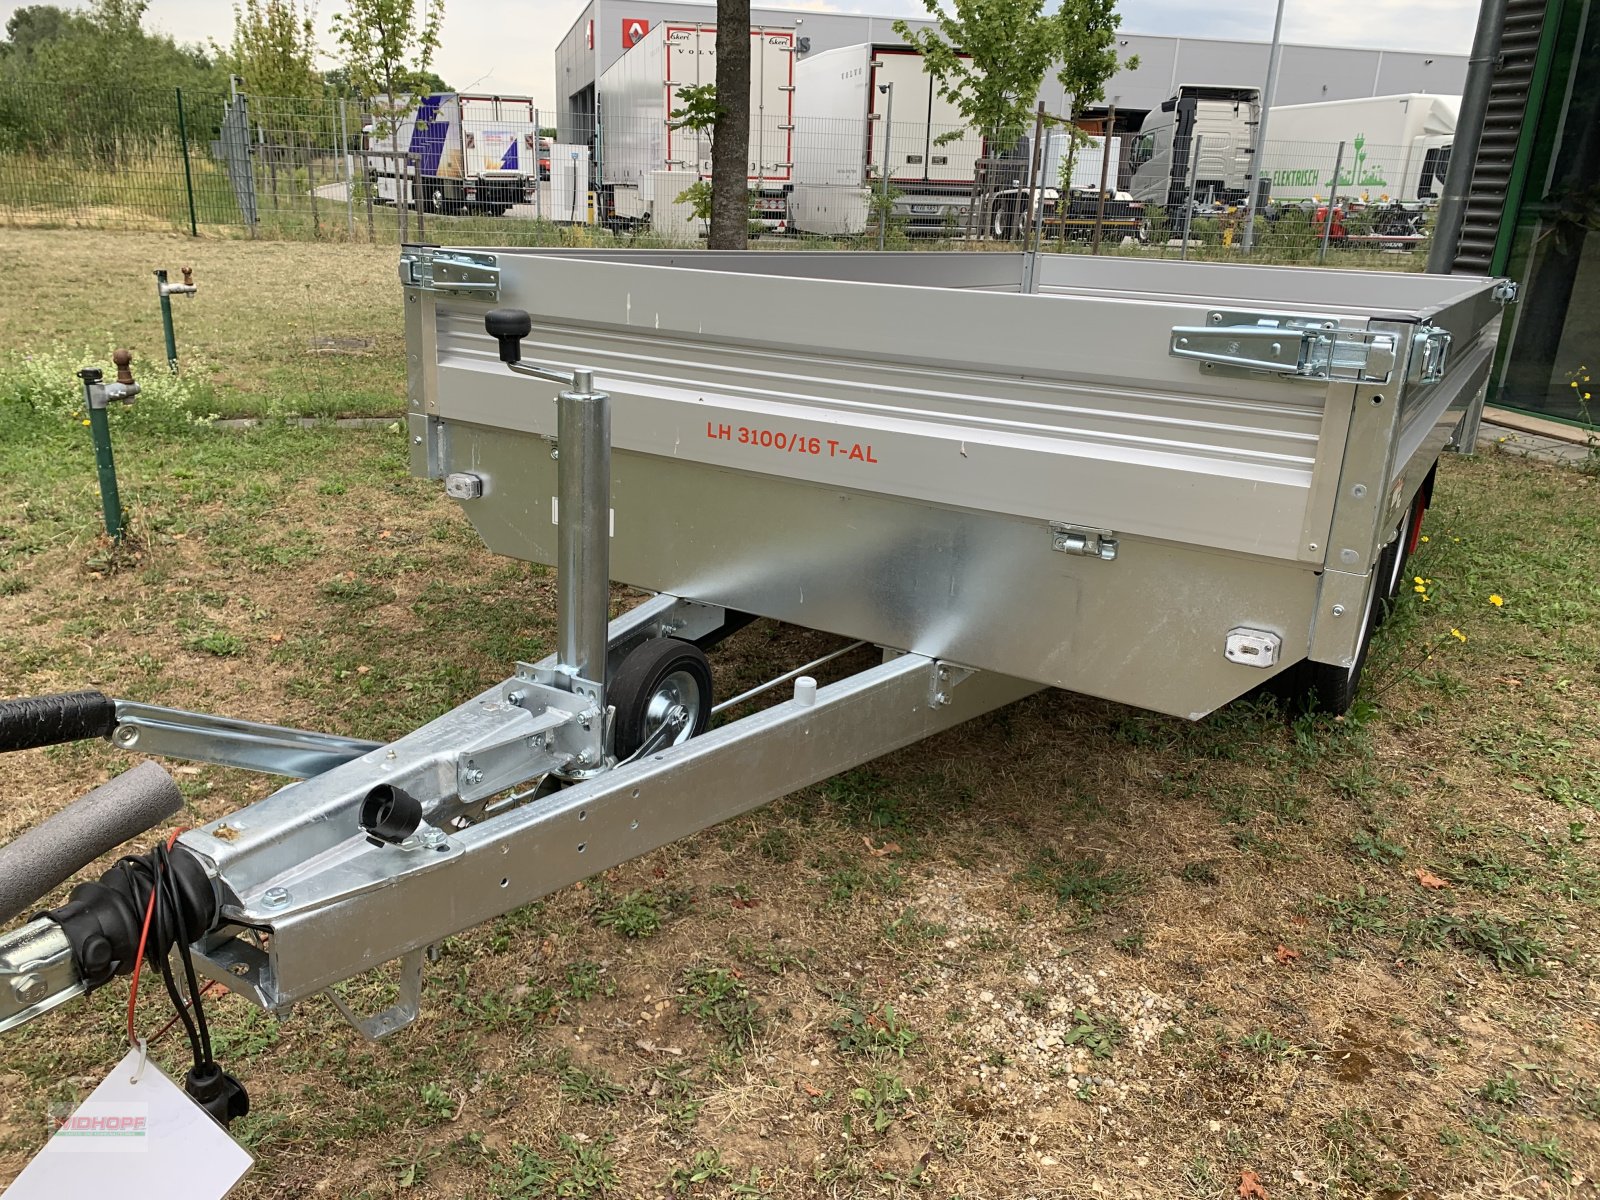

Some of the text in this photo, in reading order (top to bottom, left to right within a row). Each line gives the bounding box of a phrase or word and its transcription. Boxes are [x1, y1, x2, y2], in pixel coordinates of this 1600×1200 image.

[1273, 169, 1320, 186] ELEKTRISCH
[707, 422, 878, 464] LH 3100/16 T-AL
